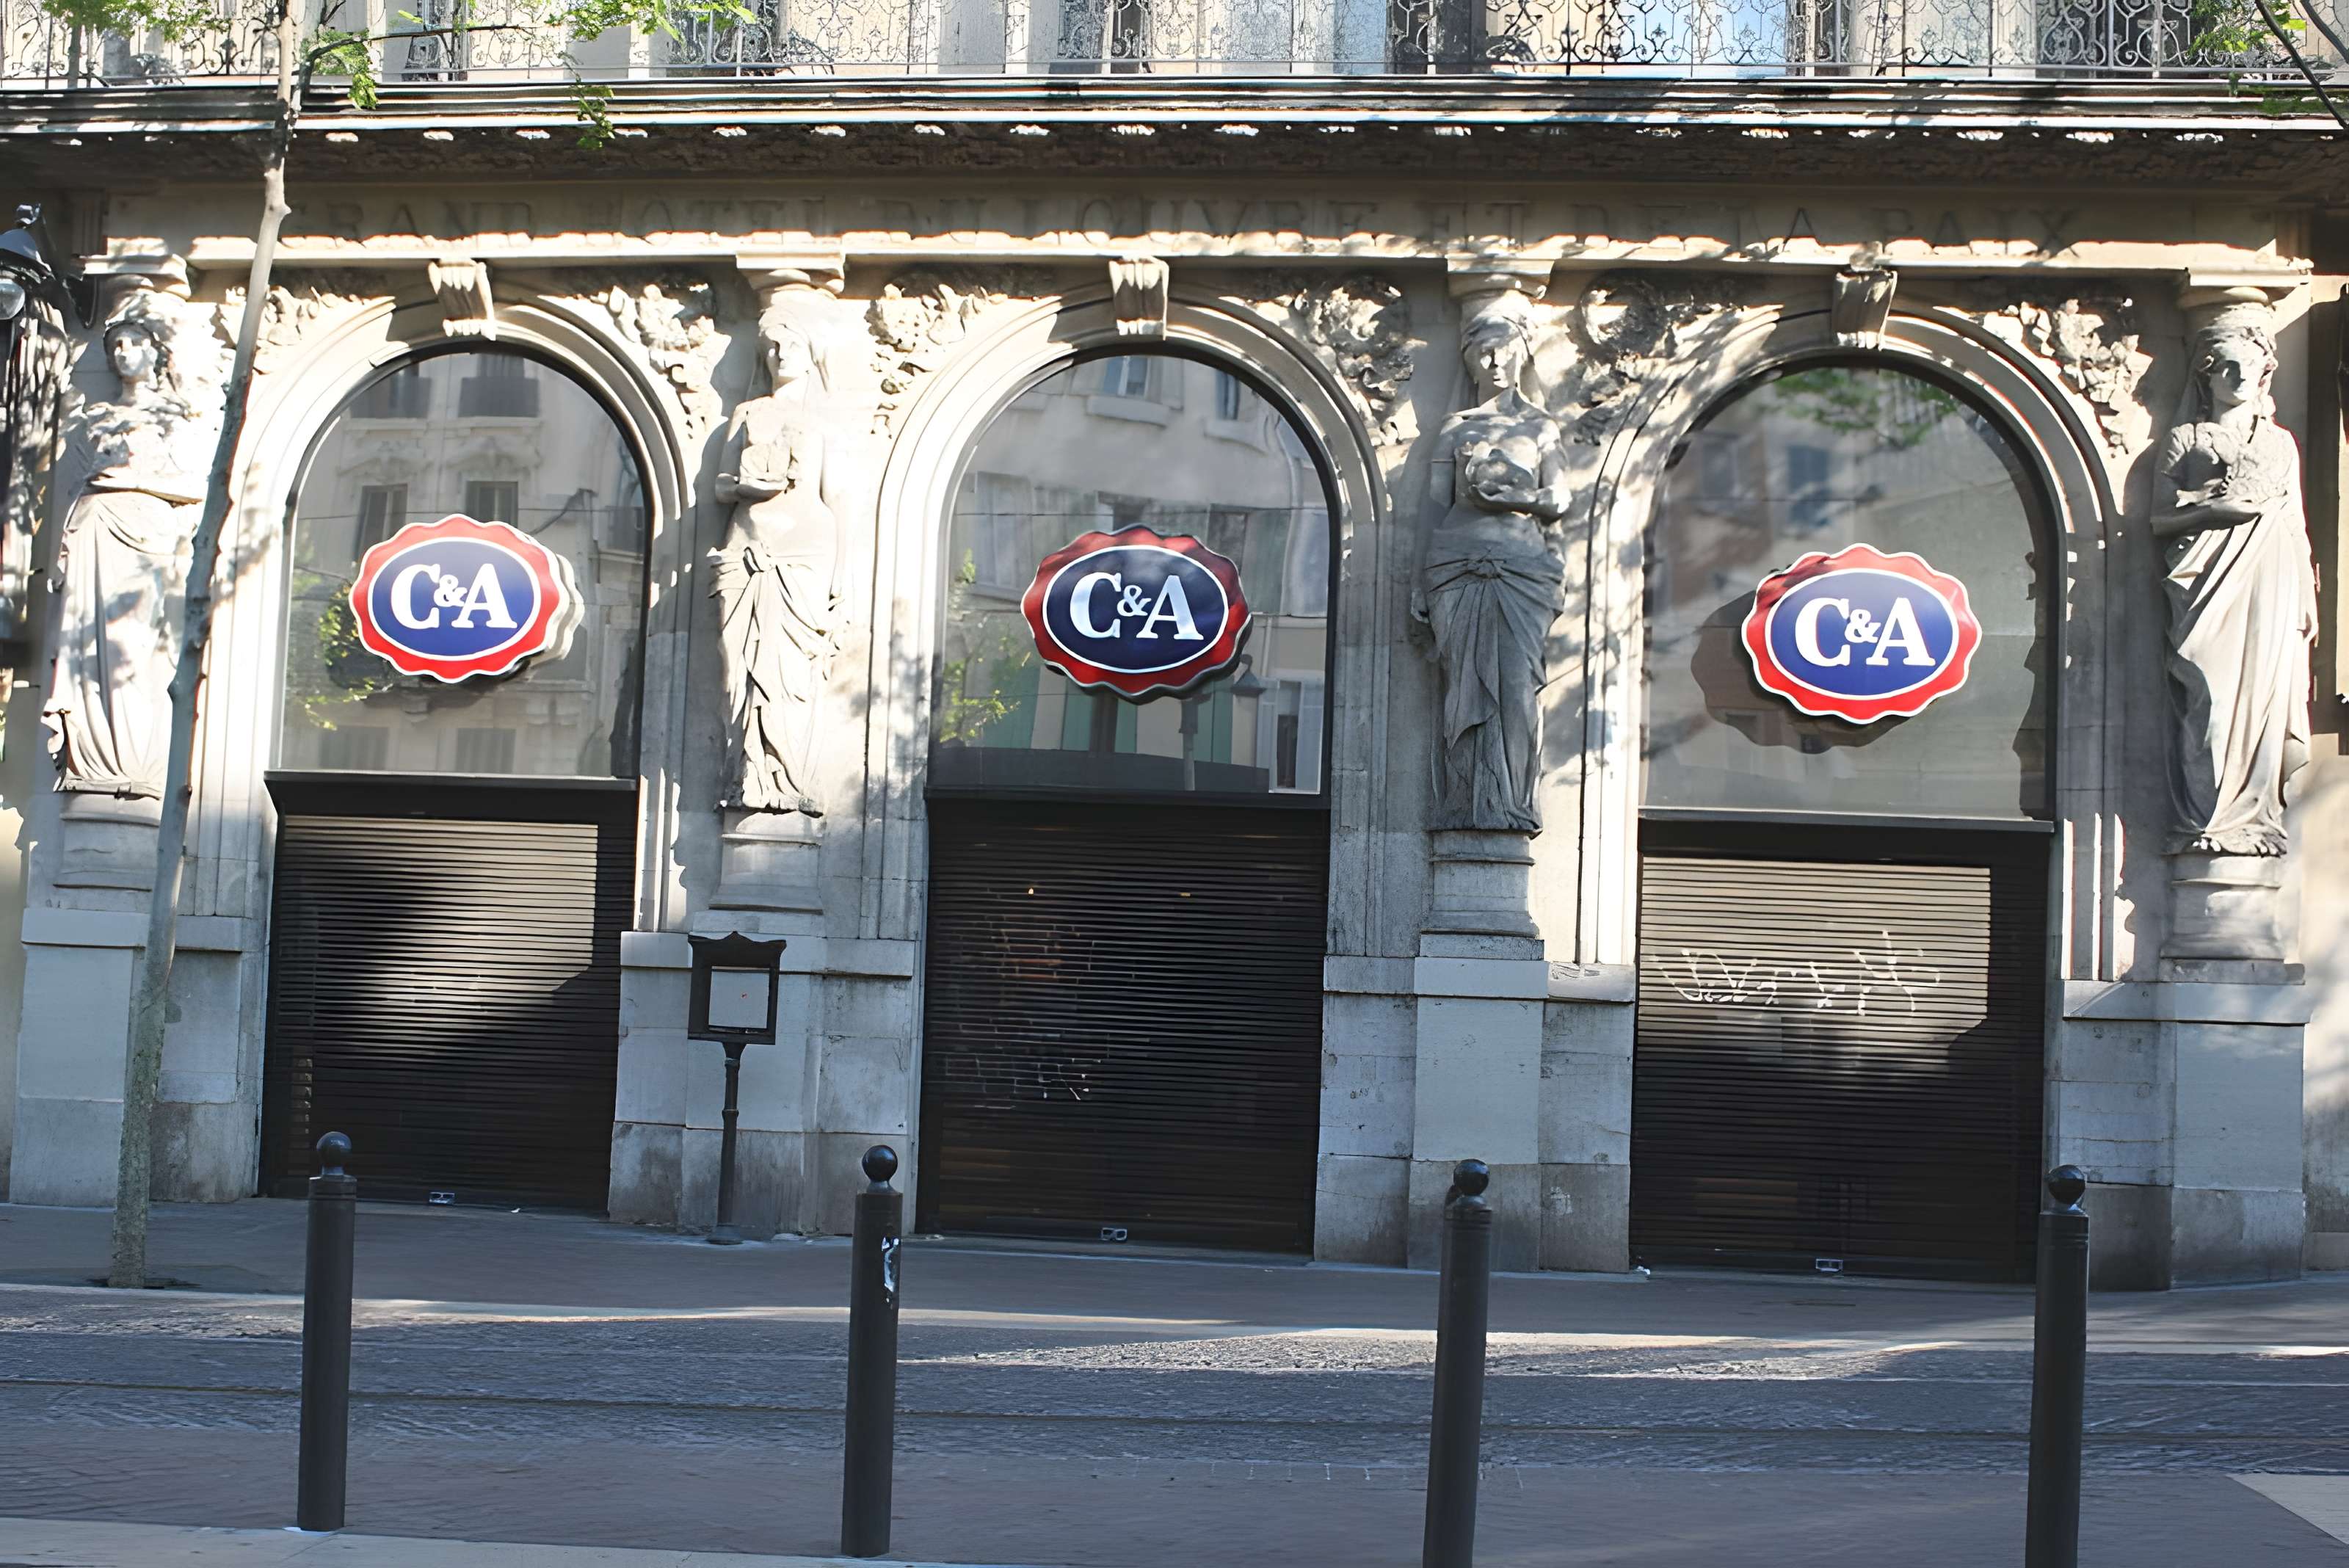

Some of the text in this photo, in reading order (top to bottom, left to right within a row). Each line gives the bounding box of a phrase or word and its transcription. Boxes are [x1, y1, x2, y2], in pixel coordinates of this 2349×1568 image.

[391, 563, 518, 630] C&A
[1070, 572, 1205, 640] C&A
[1795, 597, 1936, 667] C&A
